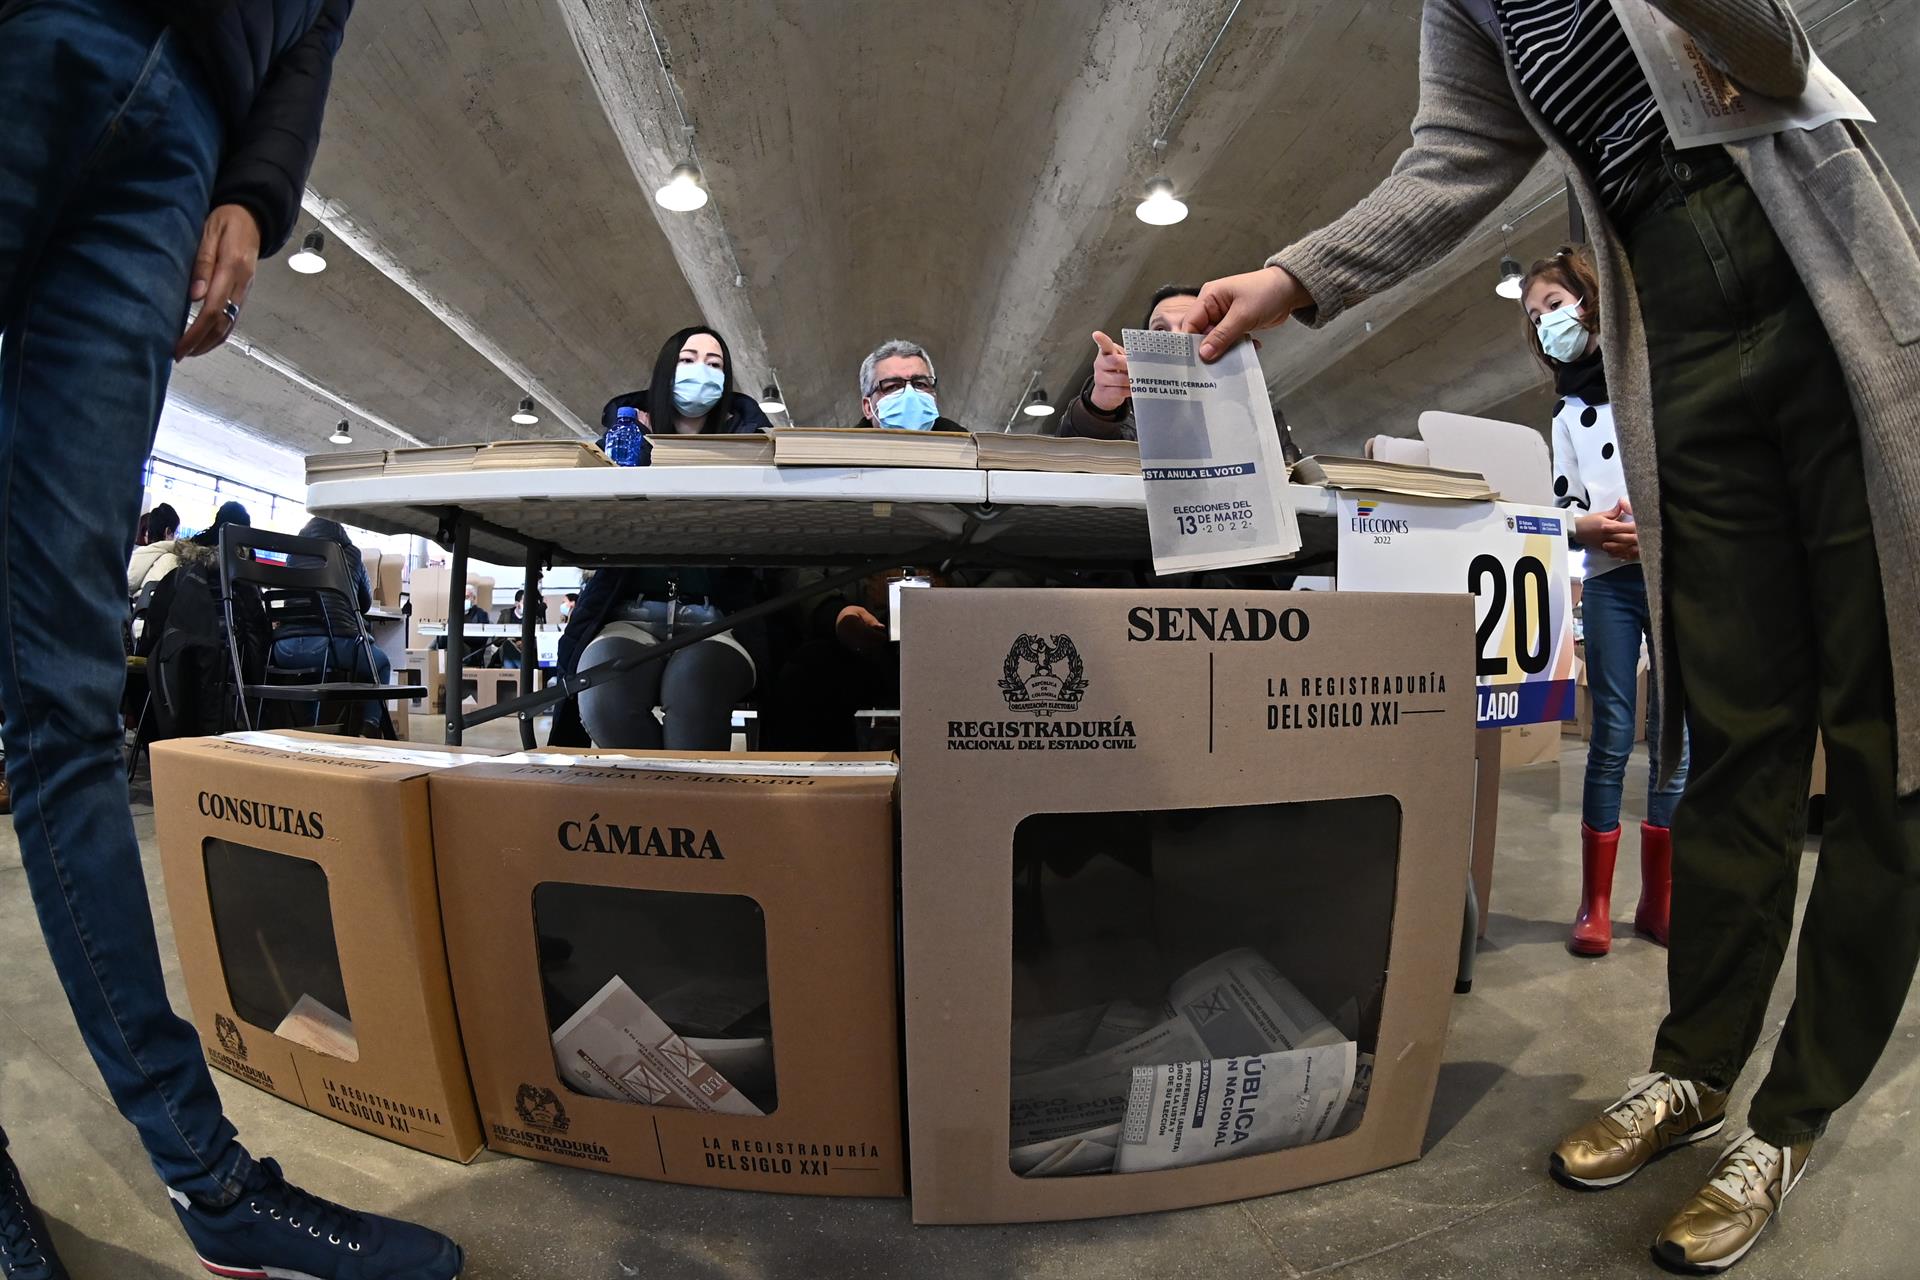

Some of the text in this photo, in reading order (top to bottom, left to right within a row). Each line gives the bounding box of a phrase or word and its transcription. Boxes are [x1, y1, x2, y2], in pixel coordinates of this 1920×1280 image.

[1136, 378, 1180, 387] PREFERENTE
[1180, 381, 1217, 389] (CERRADA)
[1169, 388, 1188, 396] LISTA
[1167, 469, 1197, 479] ANULA
[1200, 468, 1212, 477] EL
[1214, 466, 1243, 477] VOTO
[1174, 500, 1252, 514] ELECCIONES DEL
[1177, 509, 1253, 535] 13 DE MARZO
[1352, 518, 1409, 534] ELECCIONES
[1374, 536, 1391, 544] 2022
[1127, 607, 1310, 642] SENADO
[1468, 554, 1551, 676] 20
[1268, 672, 1446, 697] LA REGISTRADURÍA
[1268, 701, 1399, 730] DEL SIGLO XXI
[1477, 691, 1519, 722] LADO
[948, 715, 1136, 737] REGISTRADURÍA
[948, 739, 1136, 750] NACIONAL DEL ESTADO CIVIL
[575, 769, 638, 780] VOTO
[646, 774, 679, 782] SU
[684, 775, 815, 786] DEPOSITE
[198, 791, 324, 840] CONSULTAS
[558, 813, 725, 860] CÁMARA
[1165, 1088, 1172, 1098] SU
[1167, 1076, 1174, 1086] DE
[1175, 1083, 1182, 1092] DE
[1179, 1068, 1192, 1116] PREFERENTE
[322, 1078, 441, 1125] LA REGISTRADURÍA
[1173, 1095, 1180, 1104] LA
[1197, 1092, 1206, 1117] VOTAR
[1231, 1055, 1266, 1145] ÚBLICA
[328, 1093, 409, 1133] DEL SIGLO XXI
[1159, 1100, 1172, 1136] ELECCIÓN
[1169, 1106, 1178, 1126] LISTA
[1214, 1076, 1238, 1148] NACIONAL
[492, 1124, 608, 1156] REGISTRADURÍA
[702, 1136, 880, 1158] LA REGISTRADURÍA
[1172, 1118, 1185, 1153] (ABIERTA)
[495, 1135, 611, 1163] NACIONAL DEL ESTADO CIVIL
[706, 1152, 829, 1176] DEL SIGLO XXI
